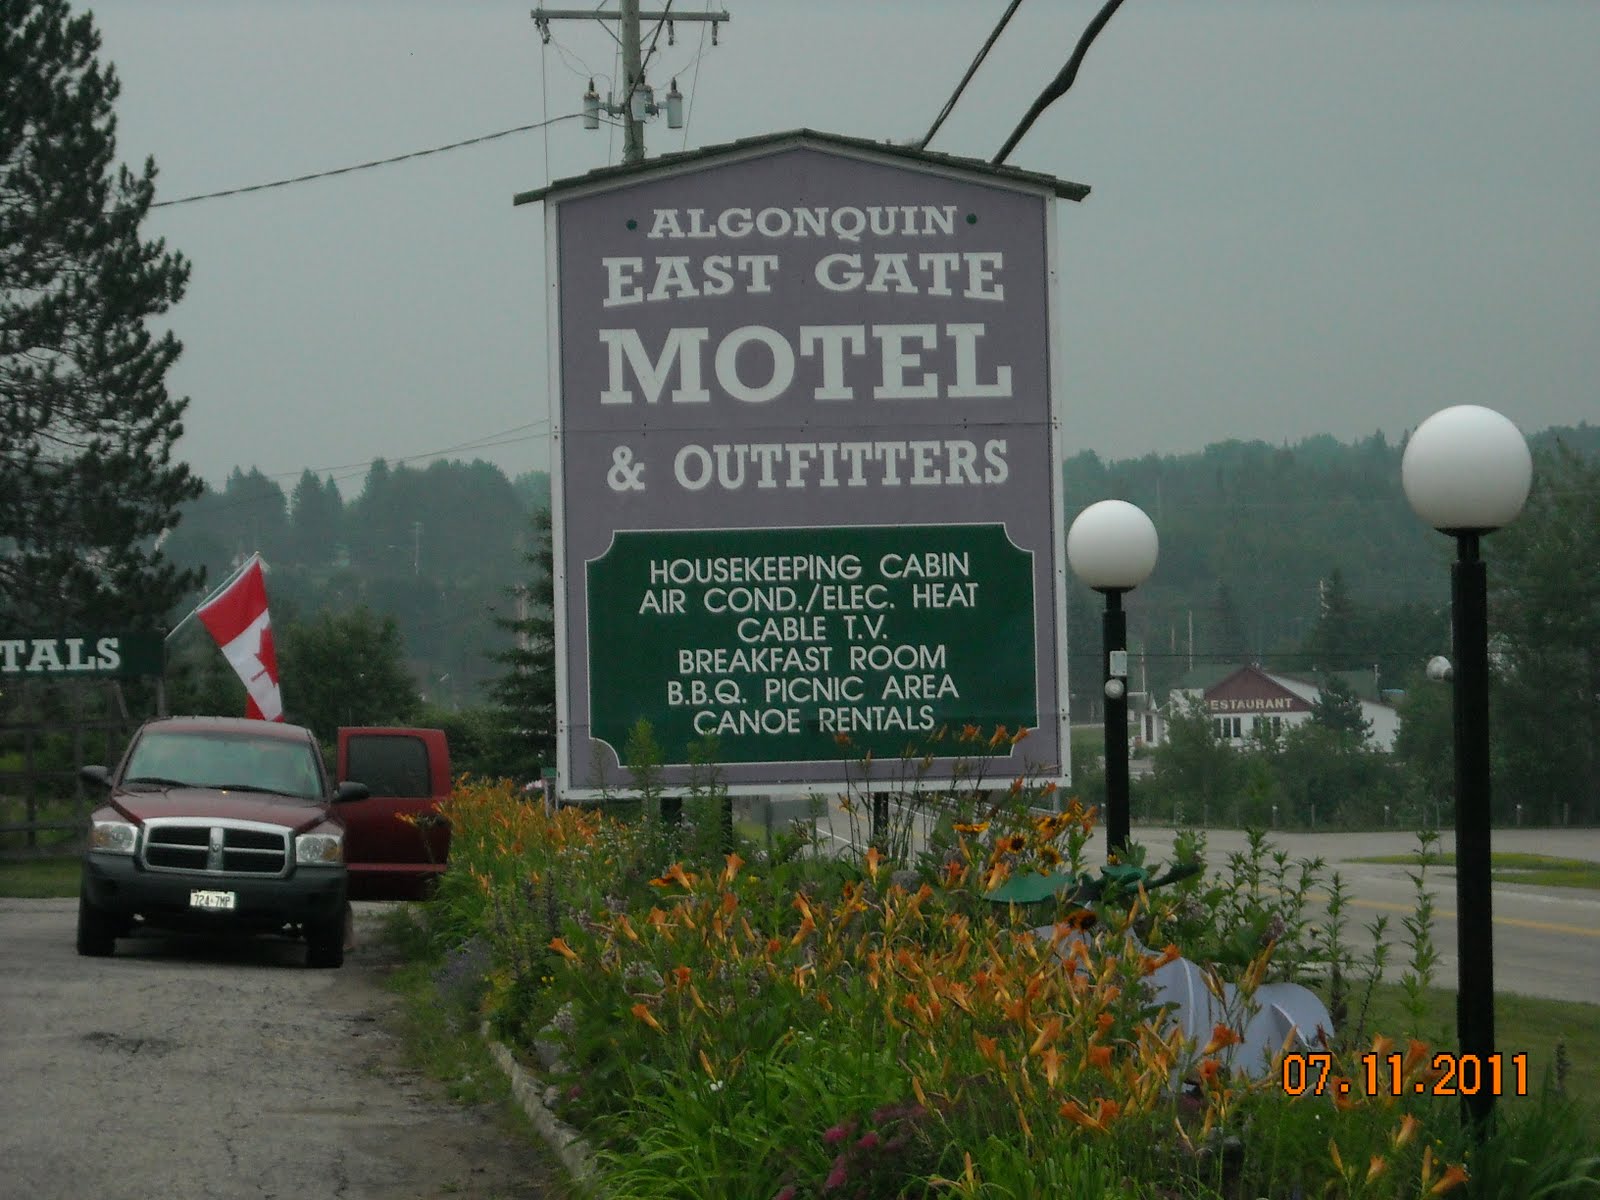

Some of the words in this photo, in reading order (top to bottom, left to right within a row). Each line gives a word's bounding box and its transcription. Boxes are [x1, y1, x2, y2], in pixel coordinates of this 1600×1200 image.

[647, 205, 958, 243] ALGONQUIN
[602, 254, 779, 308] EAST
[814, 251, 1005, 302] GATE
[598, 323, 1013, 405] MOTEL
[606, 445, 646, 492] &
[673, 439, 1009, 491] OUTFITTERS
[650, 554, 863, 586] HOUSEKEEPING
[879, 551, 969, 579] CABIN
[638, 588, 686, 615] AIR
[701, 581, 895, 613] COND./ELEC.
[912, 582, 979, 609] HEAT
[737, 616, 827, 643] CABLE
[843, 614, 888, 640] T.V.
[0, 637, 121, 673] TALS
[679, 646, 833, 674] BREAKFAST
[850, 644, 946, 671] ROOM
[667, 679, 747, 706] B.B.Q.
[765, 675, 864, 703] PICNIC
[881, 673, 960, 700] AREA
[1205, 698, 1292, 711] ESTAURANT
[693, 708, 801, 736] CANOE
[818, 704, 935, 733] RENTALS
